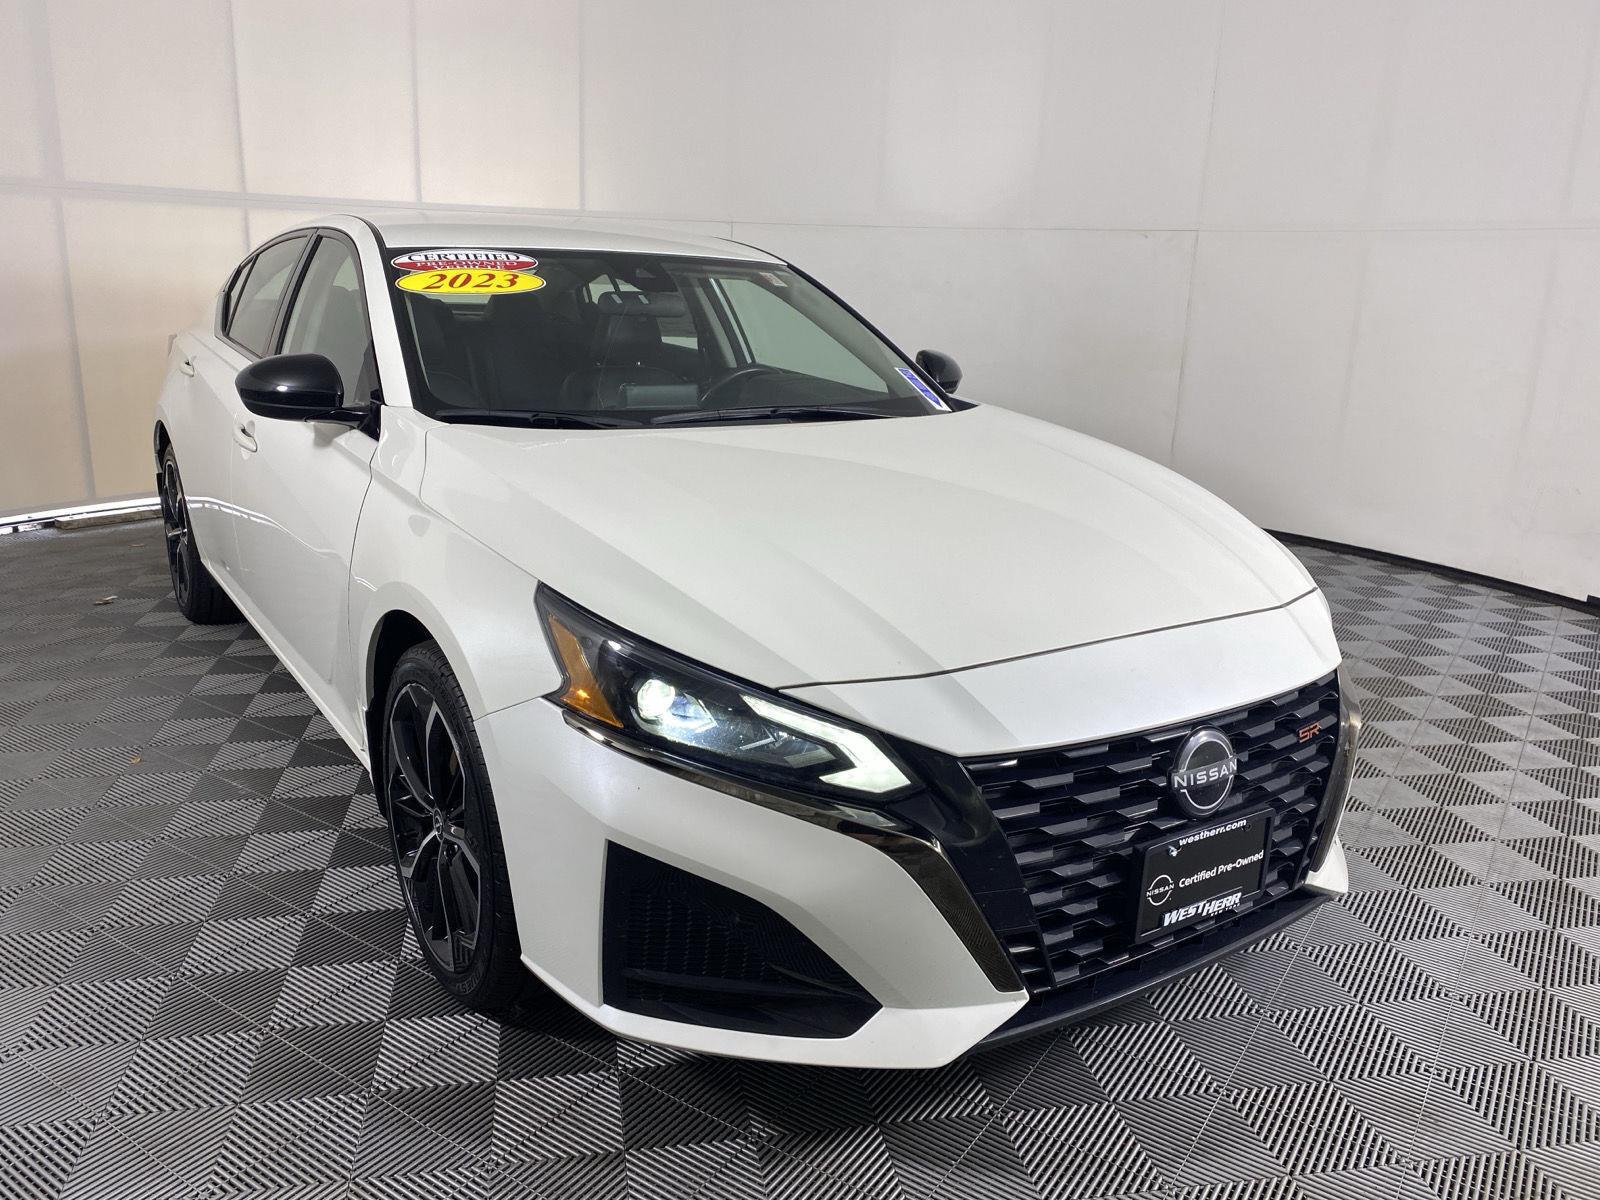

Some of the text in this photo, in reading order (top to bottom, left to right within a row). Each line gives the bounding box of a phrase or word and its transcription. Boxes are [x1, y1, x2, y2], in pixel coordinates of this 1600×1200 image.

[408, 253, 520, 261] CERTIFIED
[423, 273, 520, 290] 2023
[1298, 721, 1320, 743] SR
[1174, 759, 1237, 788] NISSAN
[1179, 819, 1247, 845] westherr.com
[1178, 849, 1264, 888] Certified Pre-Owned
[1146, 883, 1175, 897] NISSAN
